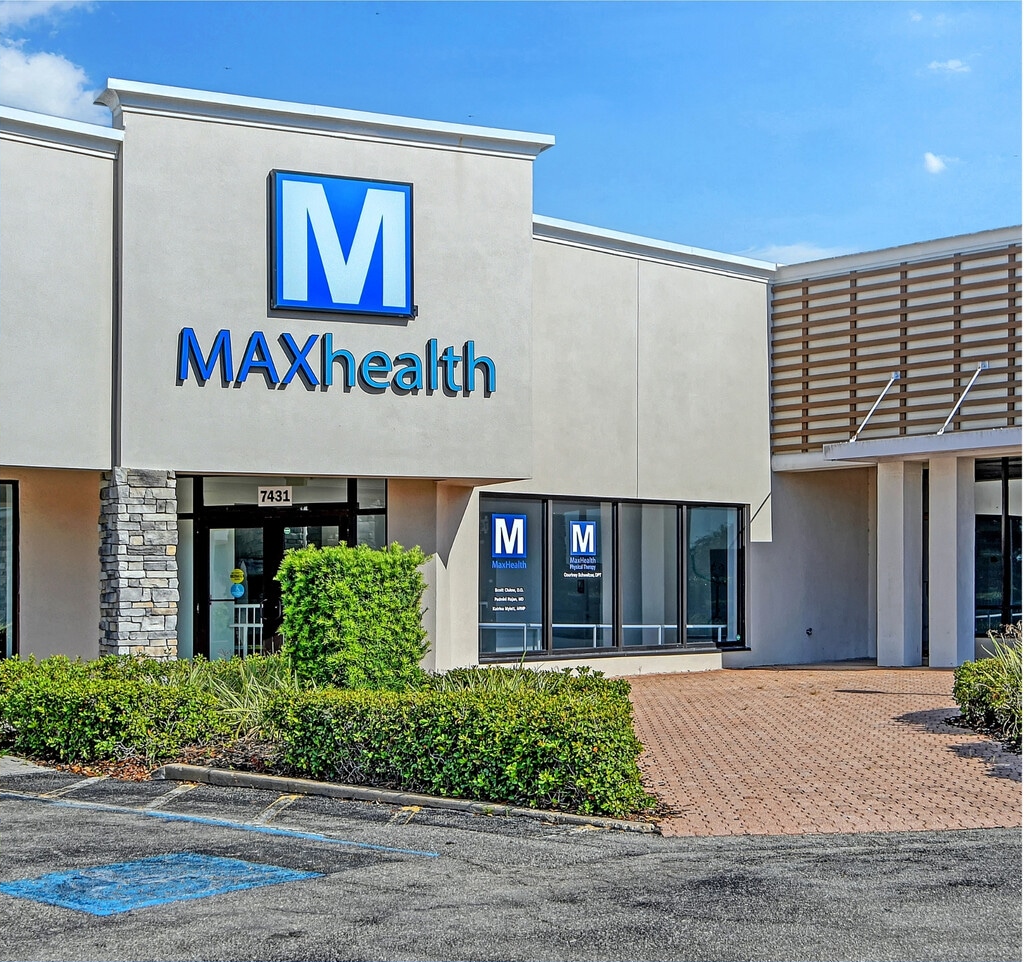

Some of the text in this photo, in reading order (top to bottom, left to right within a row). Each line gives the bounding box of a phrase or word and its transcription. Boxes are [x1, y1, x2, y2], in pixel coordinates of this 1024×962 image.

[281, 179, 406, 308] M
[178, 327, 496, 395] MAXhealth
[260, 490, 291, 502] 7431
[495, 518, 523, 554] M
[572, 524, 594, 553] M
[491, 560, 527, 569] MaxHealth
